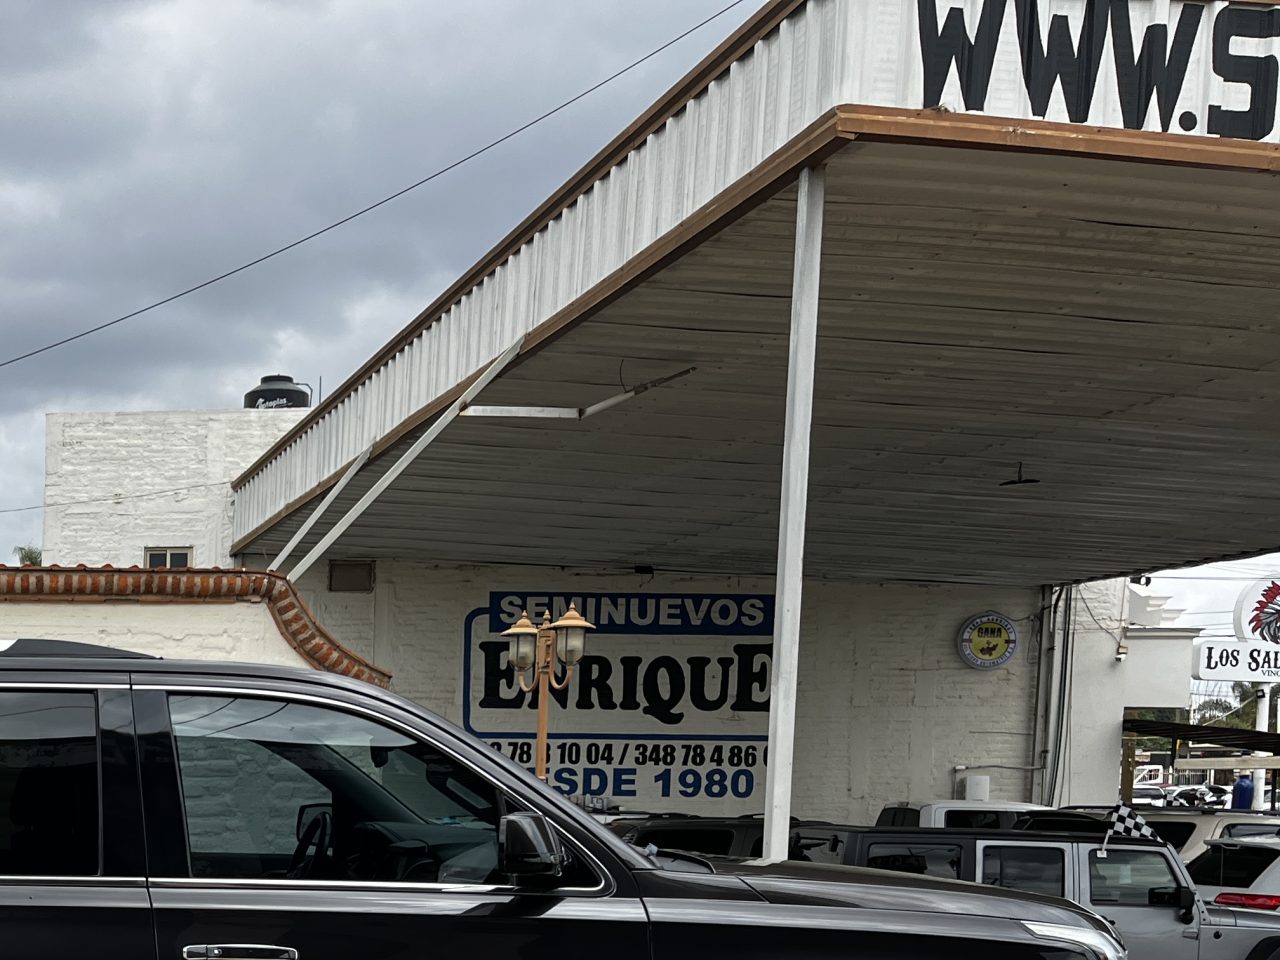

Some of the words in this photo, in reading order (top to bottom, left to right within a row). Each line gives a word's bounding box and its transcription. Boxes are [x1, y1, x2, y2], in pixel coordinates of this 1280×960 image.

[500, 595, 765, 626] SEMINUEVOS
[508, 742, 532, 763] 78
[557, 743, 580, 764] 10
[587, 743, 614, 765] 04
[634, 744, 676, 766] 348
[681, 744, 705, 766] 78
[710, 745, 724, 766] 4
[728, 745, 757, 767] 86
[654, 768, 755, 798] 1980
